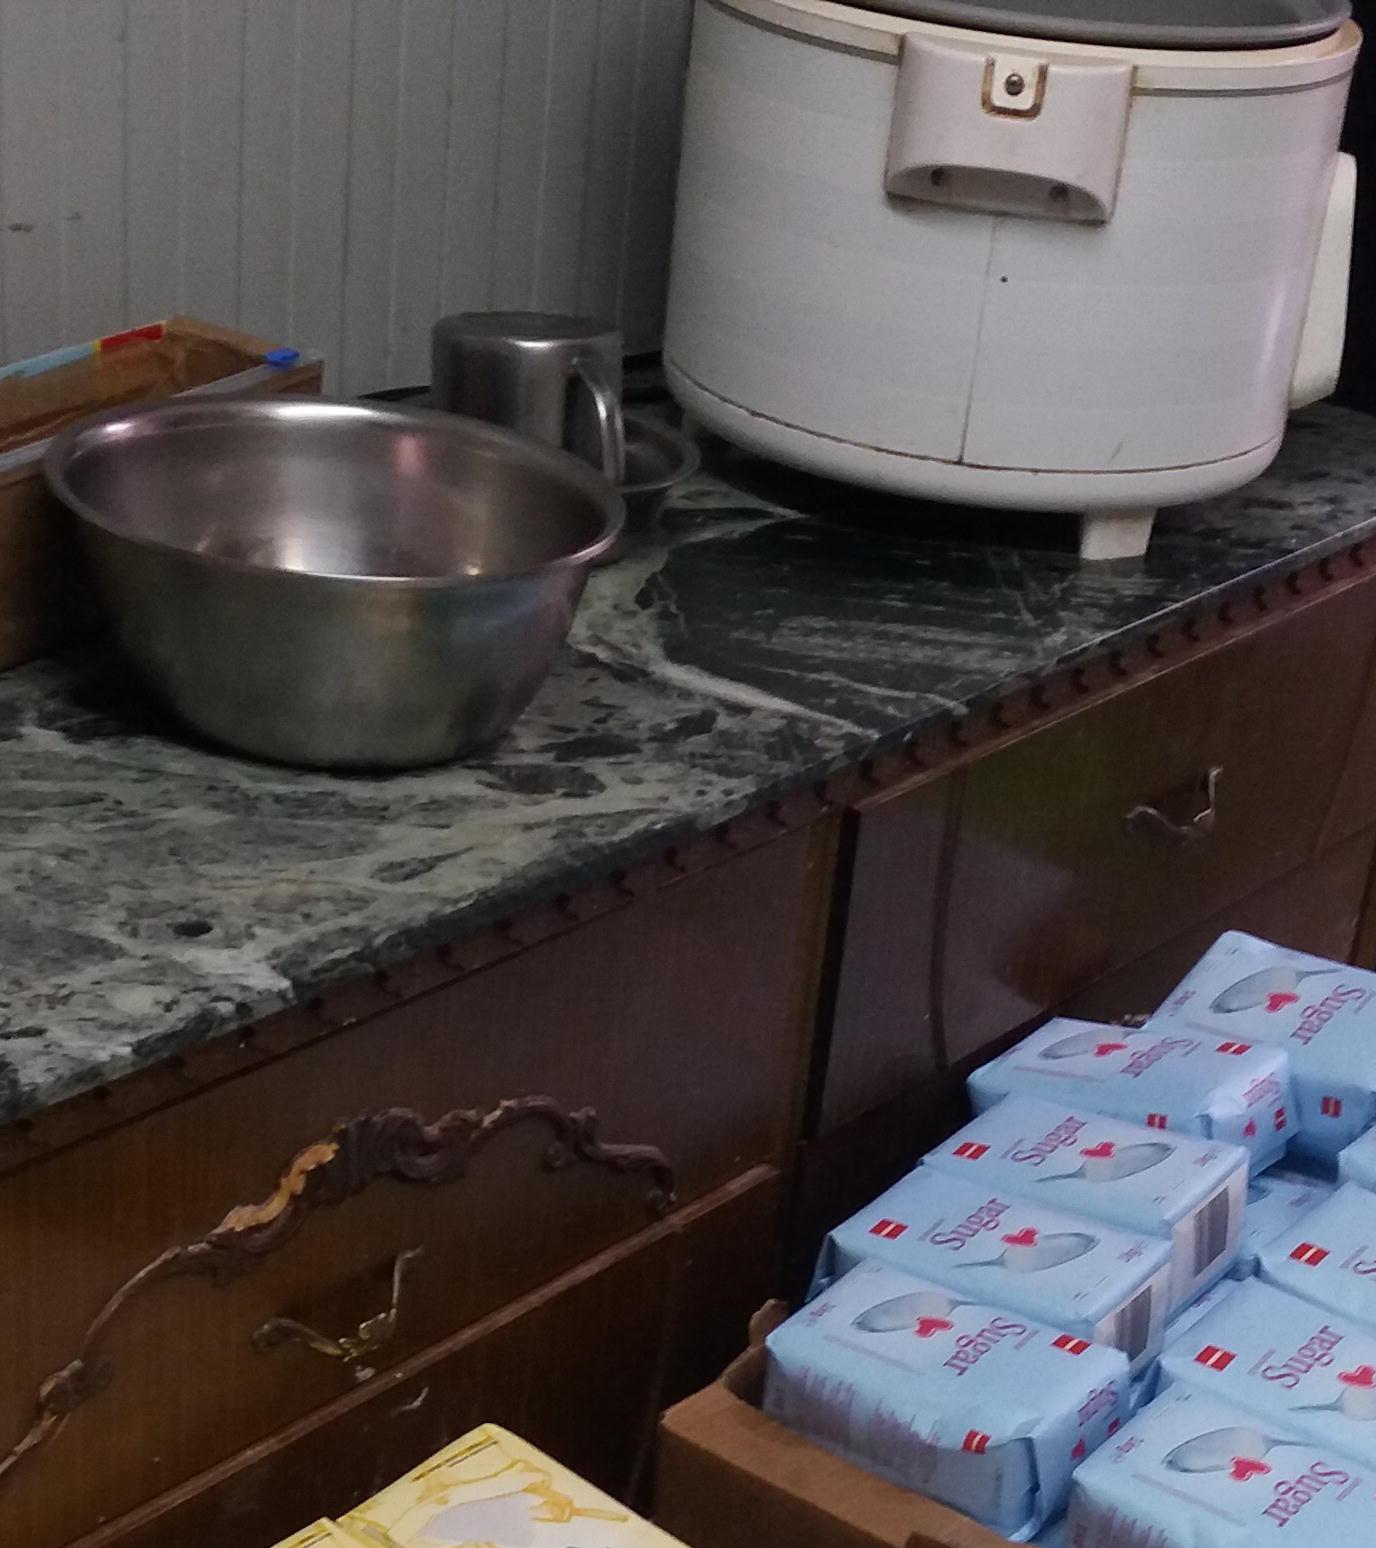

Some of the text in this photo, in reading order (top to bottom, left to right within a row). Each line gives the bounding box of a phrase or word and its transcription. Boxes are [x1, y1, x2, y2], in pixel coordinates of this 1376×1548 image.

[1290, 983, 1368, 1047] Sugar
[1120, 1037, 1196, 1079] Sugar
[1010, 1115, 1089, 1167] Sugar
[930, 1197, 1012, 1251] Sugar
[943, 1315, 1027, 1377] Sugar
[1261, 1325, 1345, 1390] Sugar
[1262, 1461, 1350, 1529] Sugar
